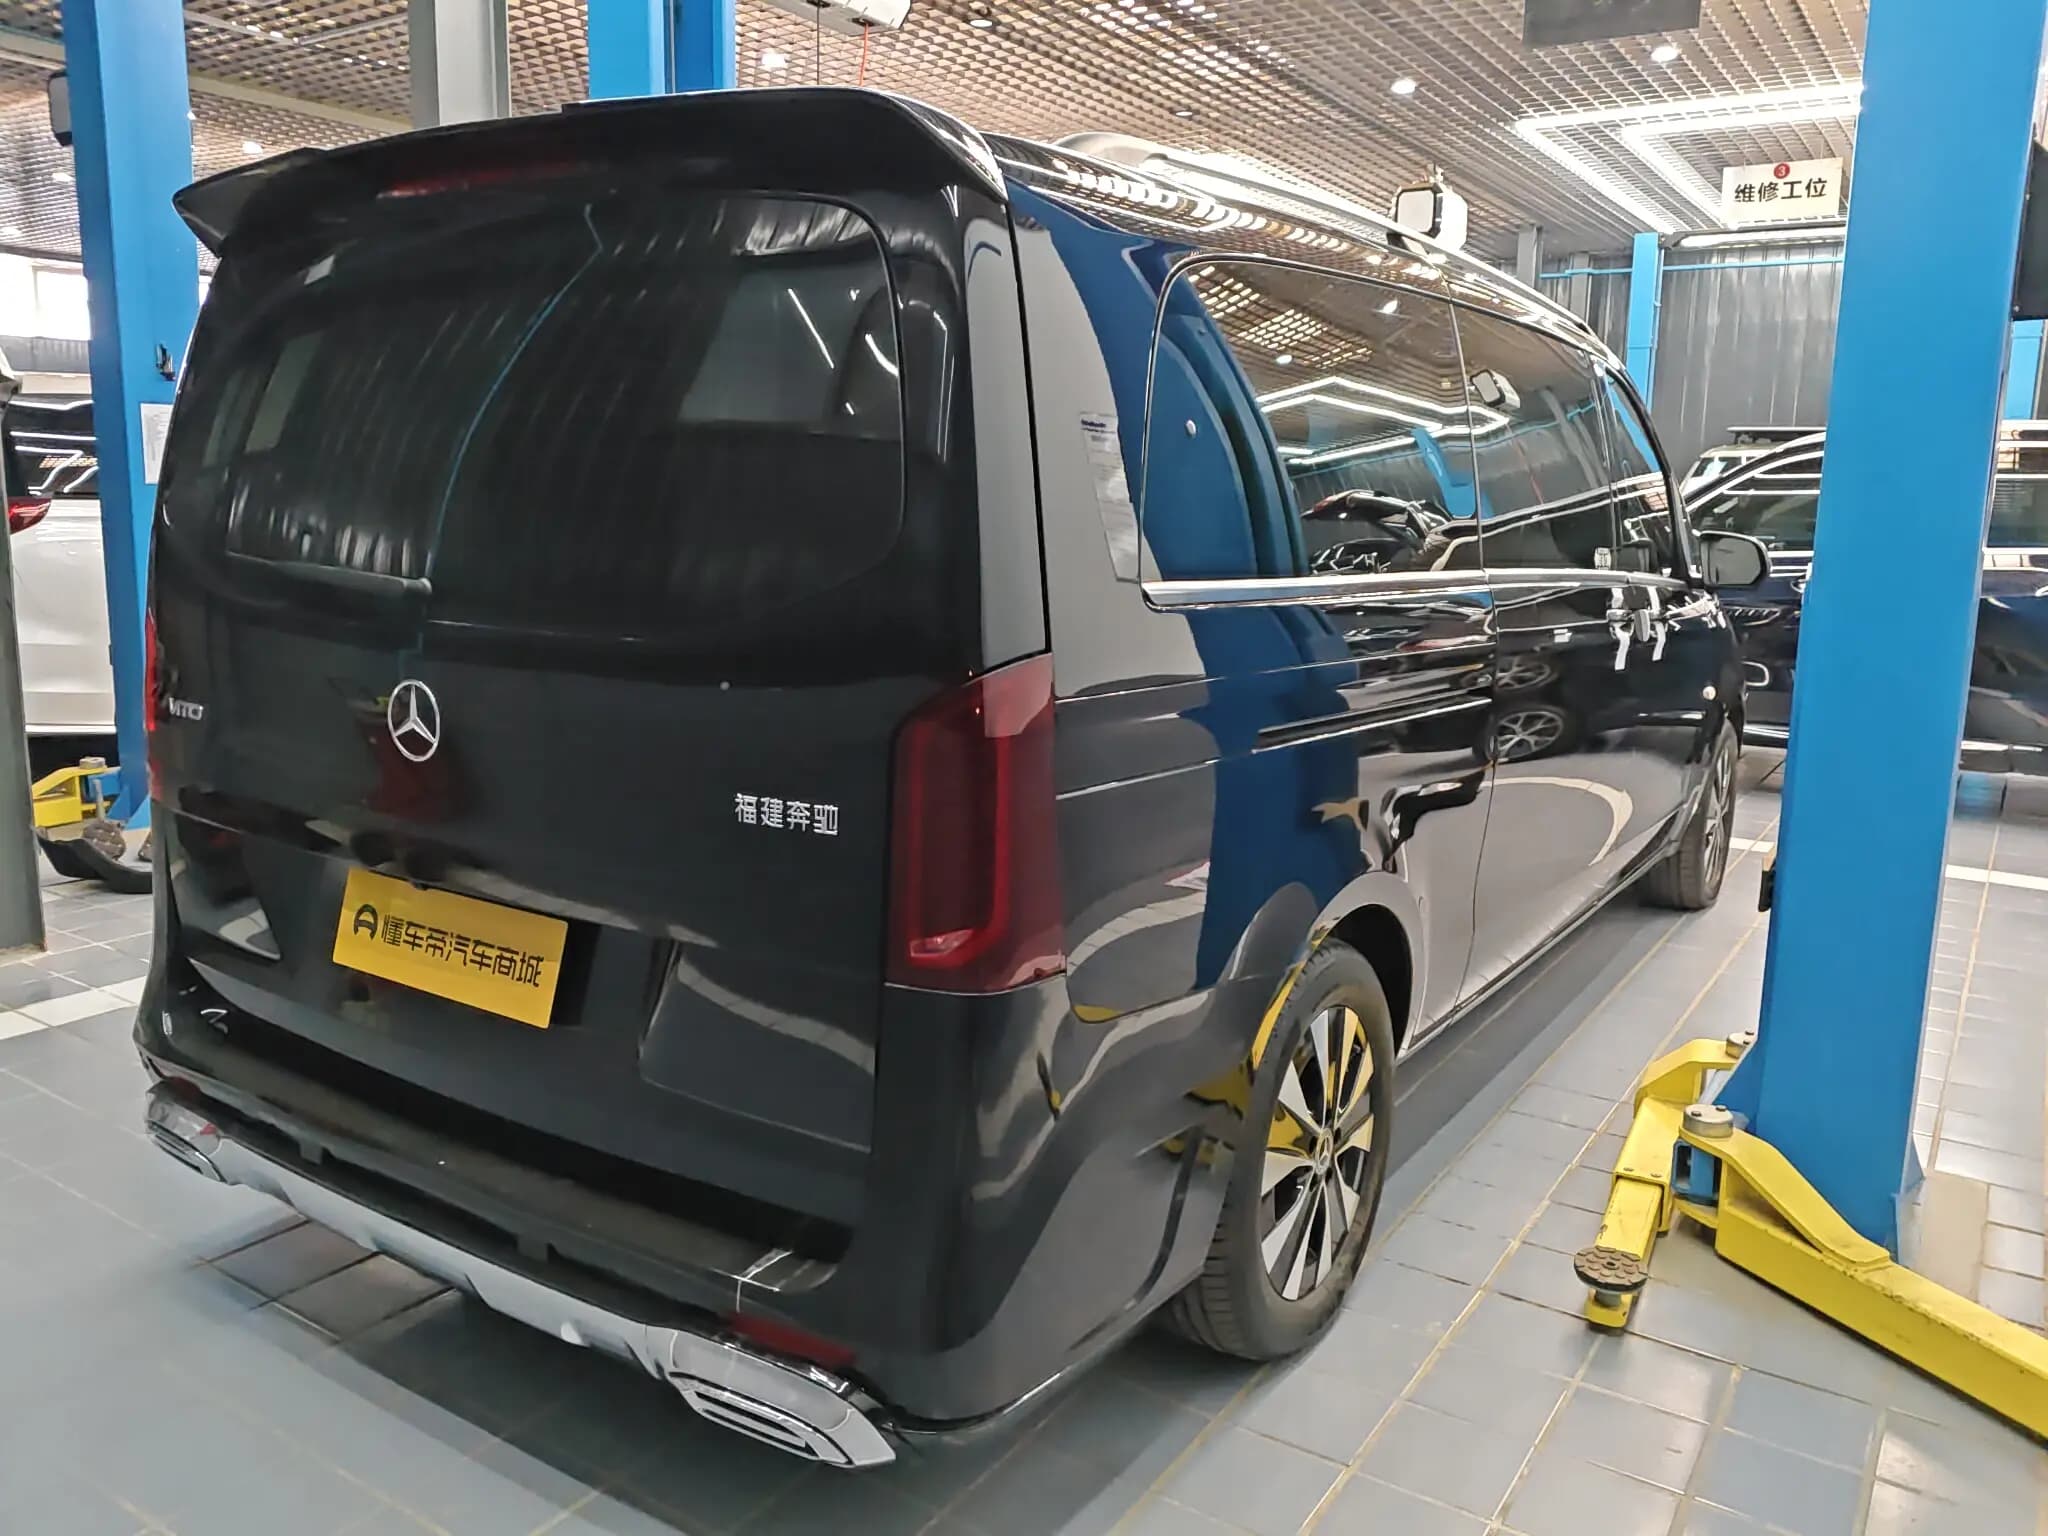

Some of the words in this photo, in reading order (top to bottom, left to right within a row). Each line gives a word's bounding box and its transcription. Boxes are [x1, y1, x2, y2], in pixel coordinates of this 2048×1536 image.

[1734, 178, 1827, 202] 维修工位
[169, 697, 203, 720] VITO
[735, 793, 838, 835] 福建奔驰
[381, 914, 545, 988] 懂车帝汽车商城
